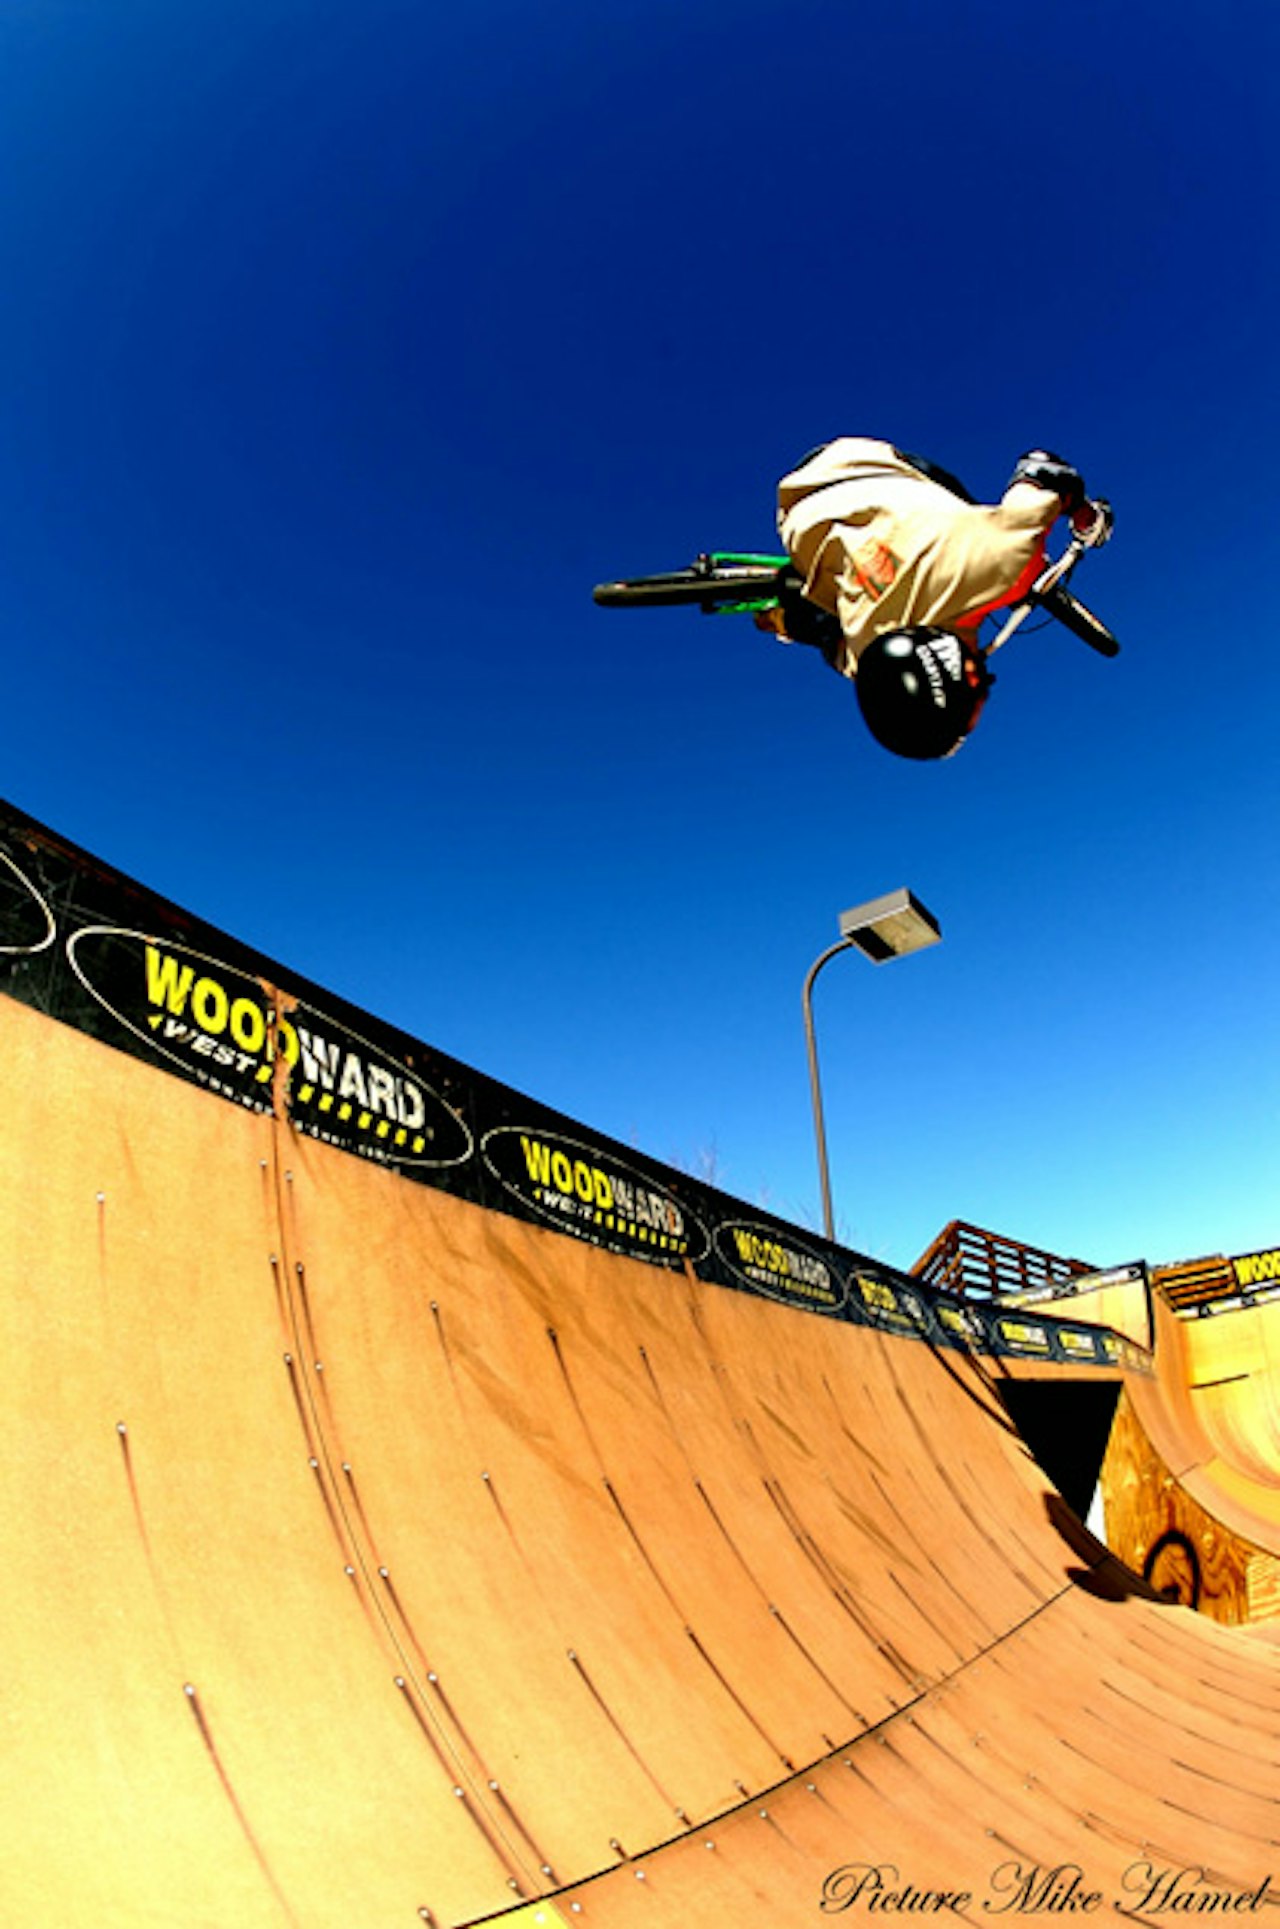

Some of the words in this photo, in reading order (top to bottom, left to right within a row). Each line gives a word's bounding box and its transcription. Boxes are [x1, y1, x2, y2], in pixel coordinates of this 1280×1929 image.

[145, 944, 426, 1129] WOODWARD
[163, 1018, 257, 1073] WEST
[520, 1135, 685, 1237] WOODWARD
